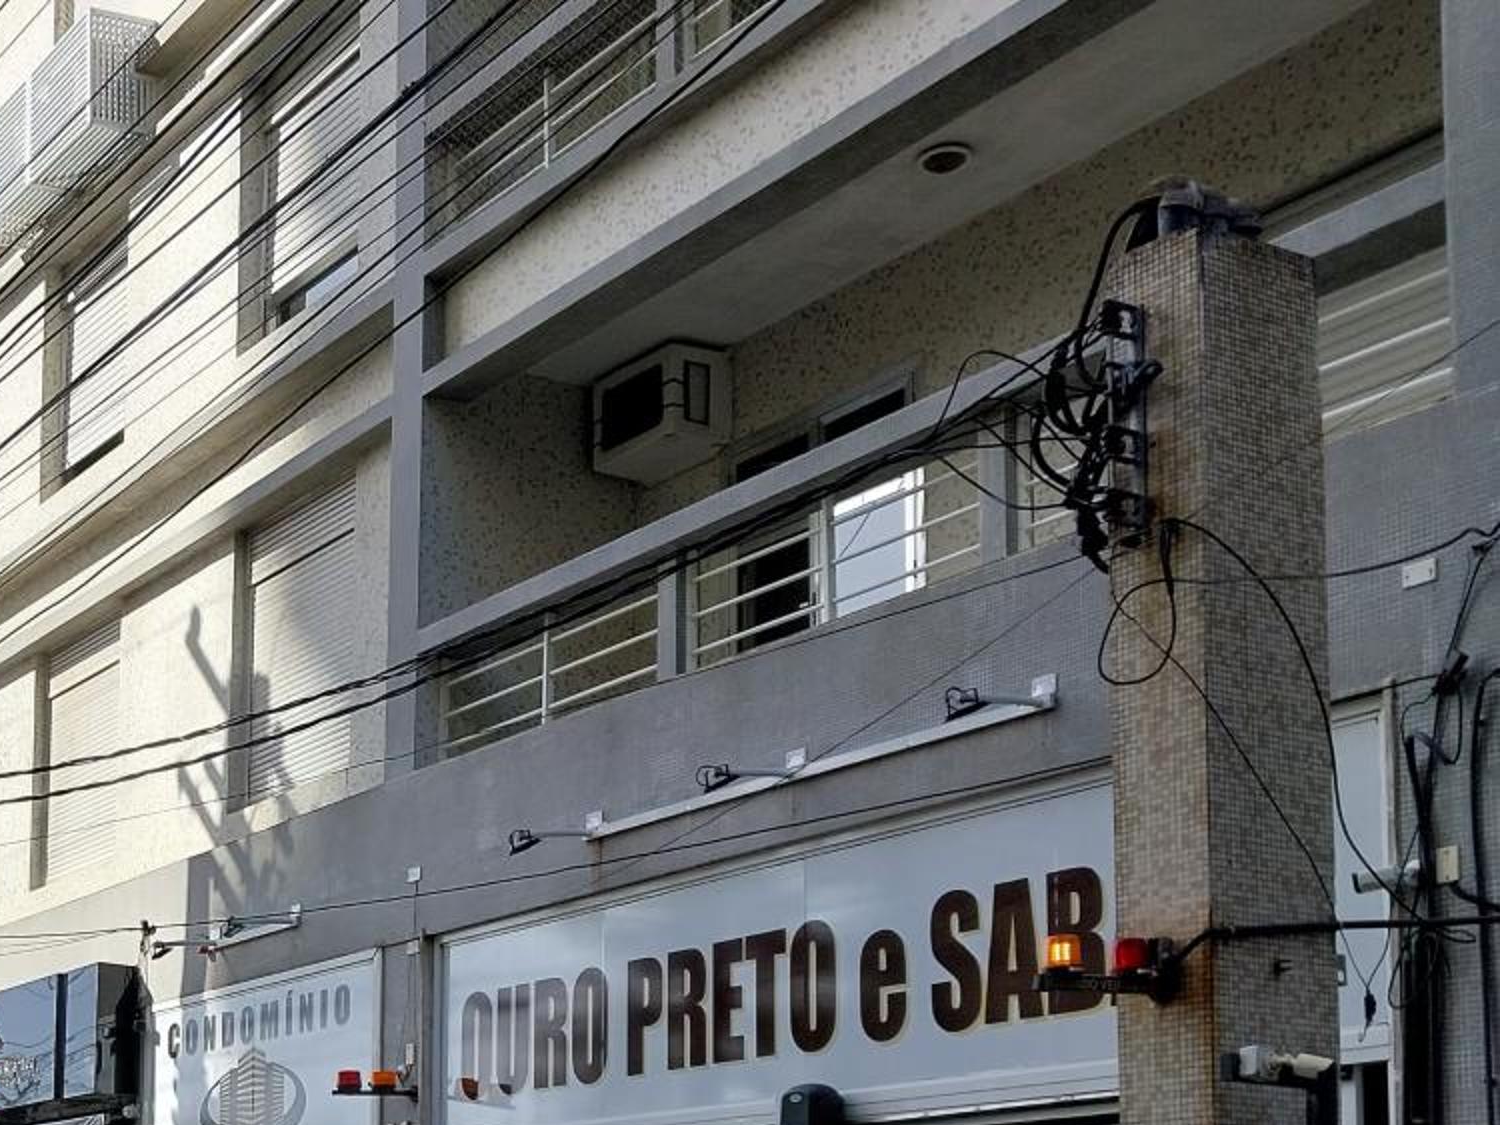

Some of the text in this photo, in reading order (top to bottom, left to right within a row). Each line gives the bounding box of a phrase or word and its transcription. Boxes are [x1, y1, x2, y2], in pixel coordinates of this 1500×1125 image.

[167, 983, 351, 1059] CONDOMÍNIO
[460, 865, 1117, 1101] OURO PRETO e SAB
